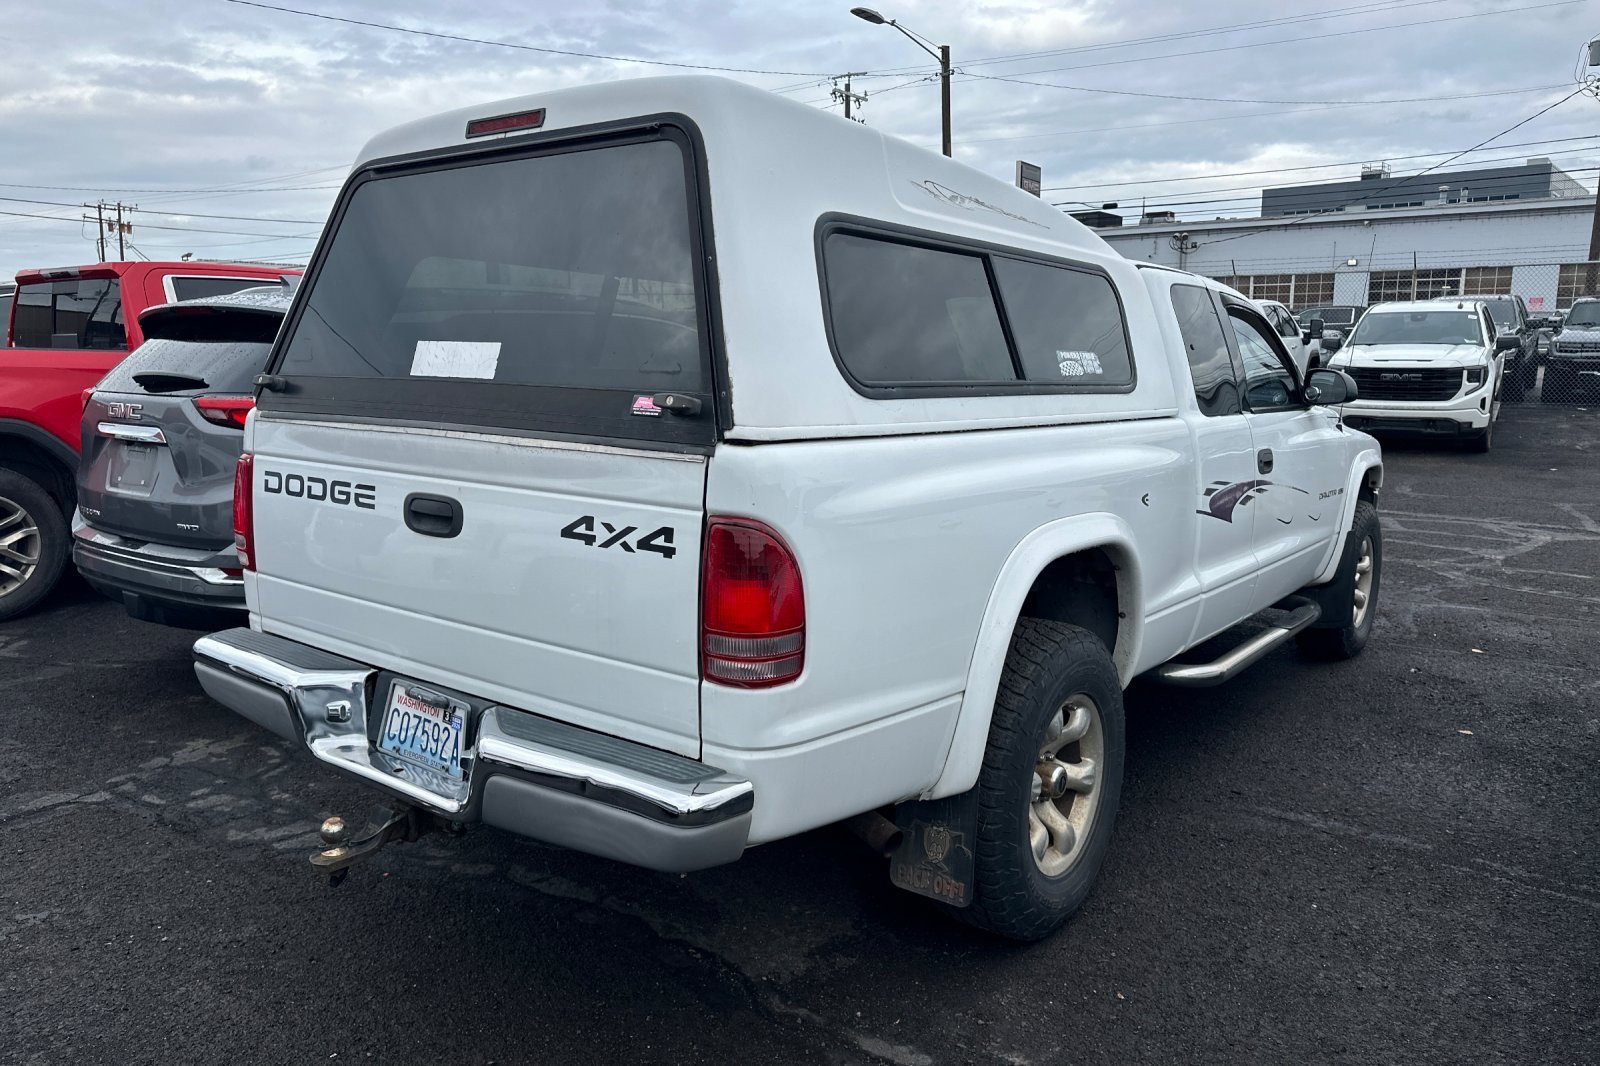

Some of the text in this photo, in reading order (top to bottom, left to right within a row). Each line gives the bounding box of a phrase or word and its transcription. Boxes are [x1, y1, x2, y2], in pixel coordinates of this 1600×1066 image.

[1380, 373, 1422, 381] GMC
[109, 402, 143, 420] GMC
[264, 470, 376, 510] DODGE
[397, 694, 440, 718] WASHINGTON
